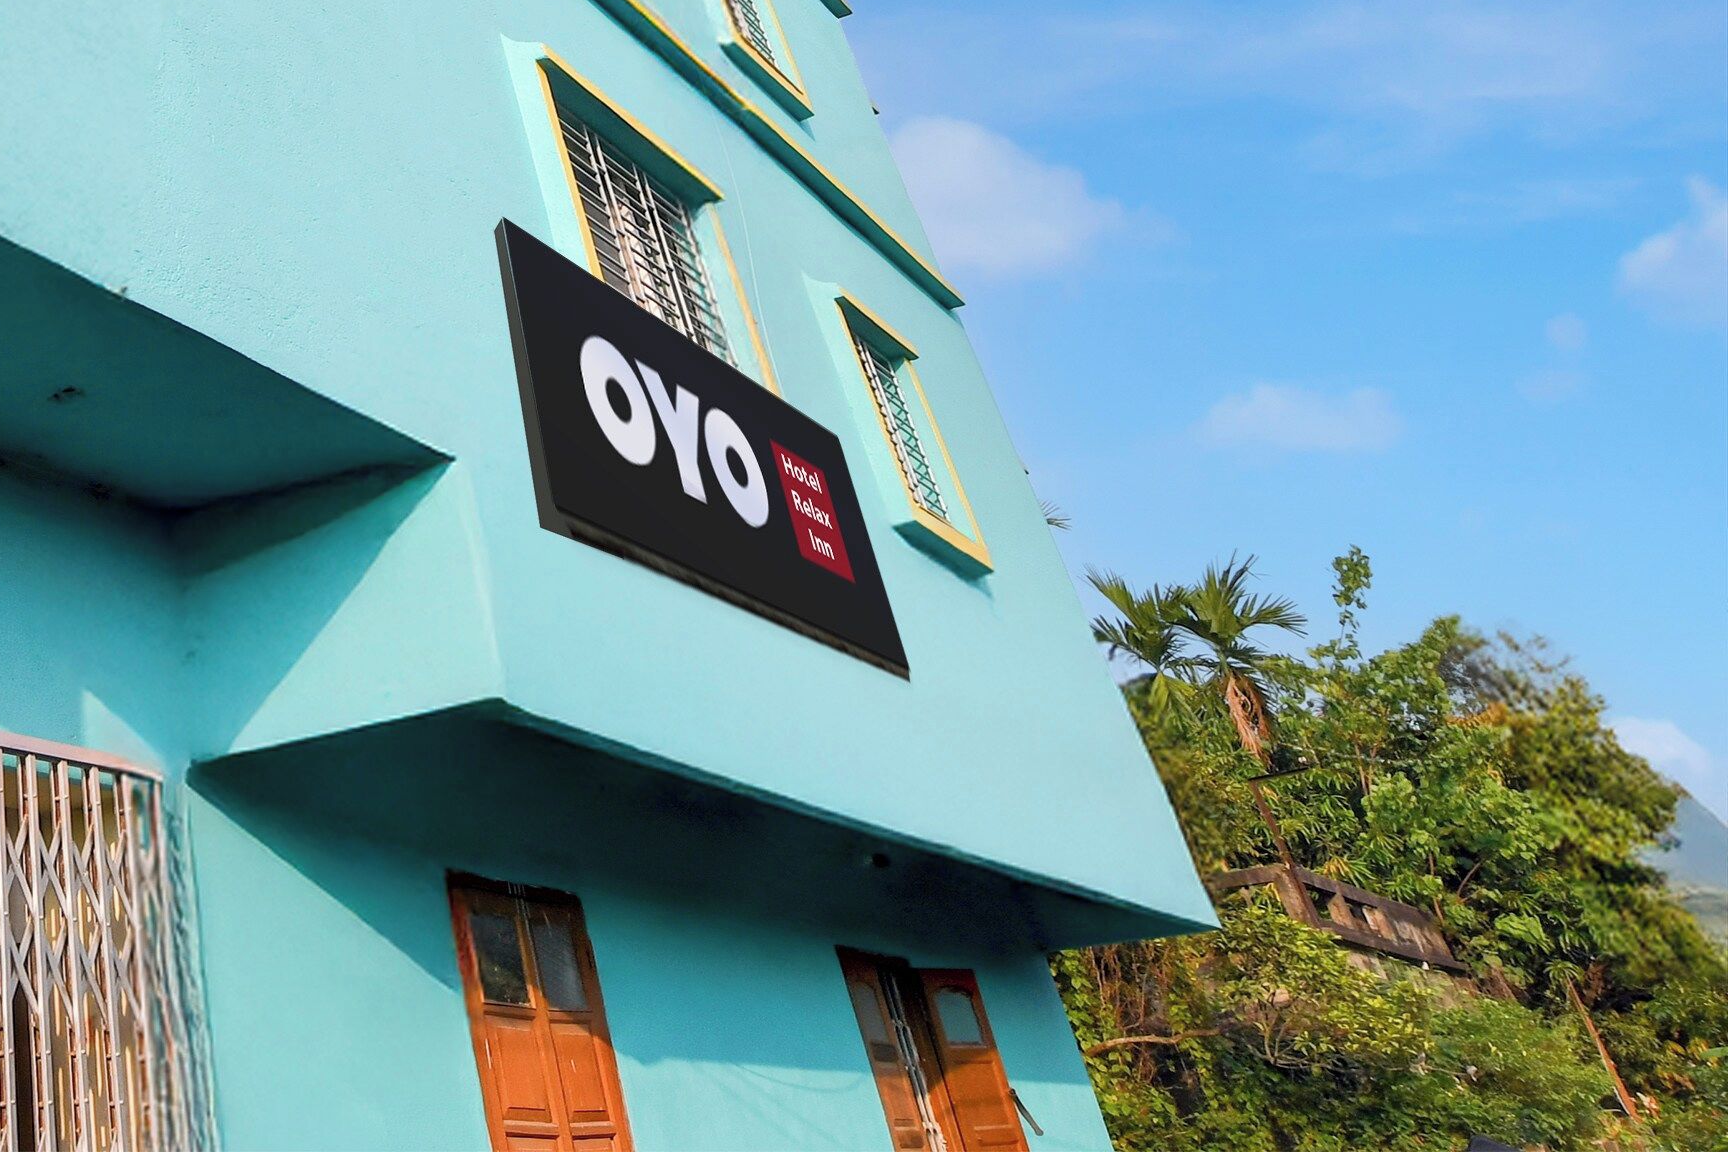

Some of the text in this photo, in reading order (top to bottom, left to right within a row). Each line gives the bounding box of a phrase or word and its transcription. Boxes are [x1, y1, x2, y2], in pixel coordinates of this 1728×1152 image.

[579, 335, 770, 529] OYO
[780, 453, 823, 494] Hotel
[790, 489, 833, 530] Relax
[807, 528, 835, 560] Inn
